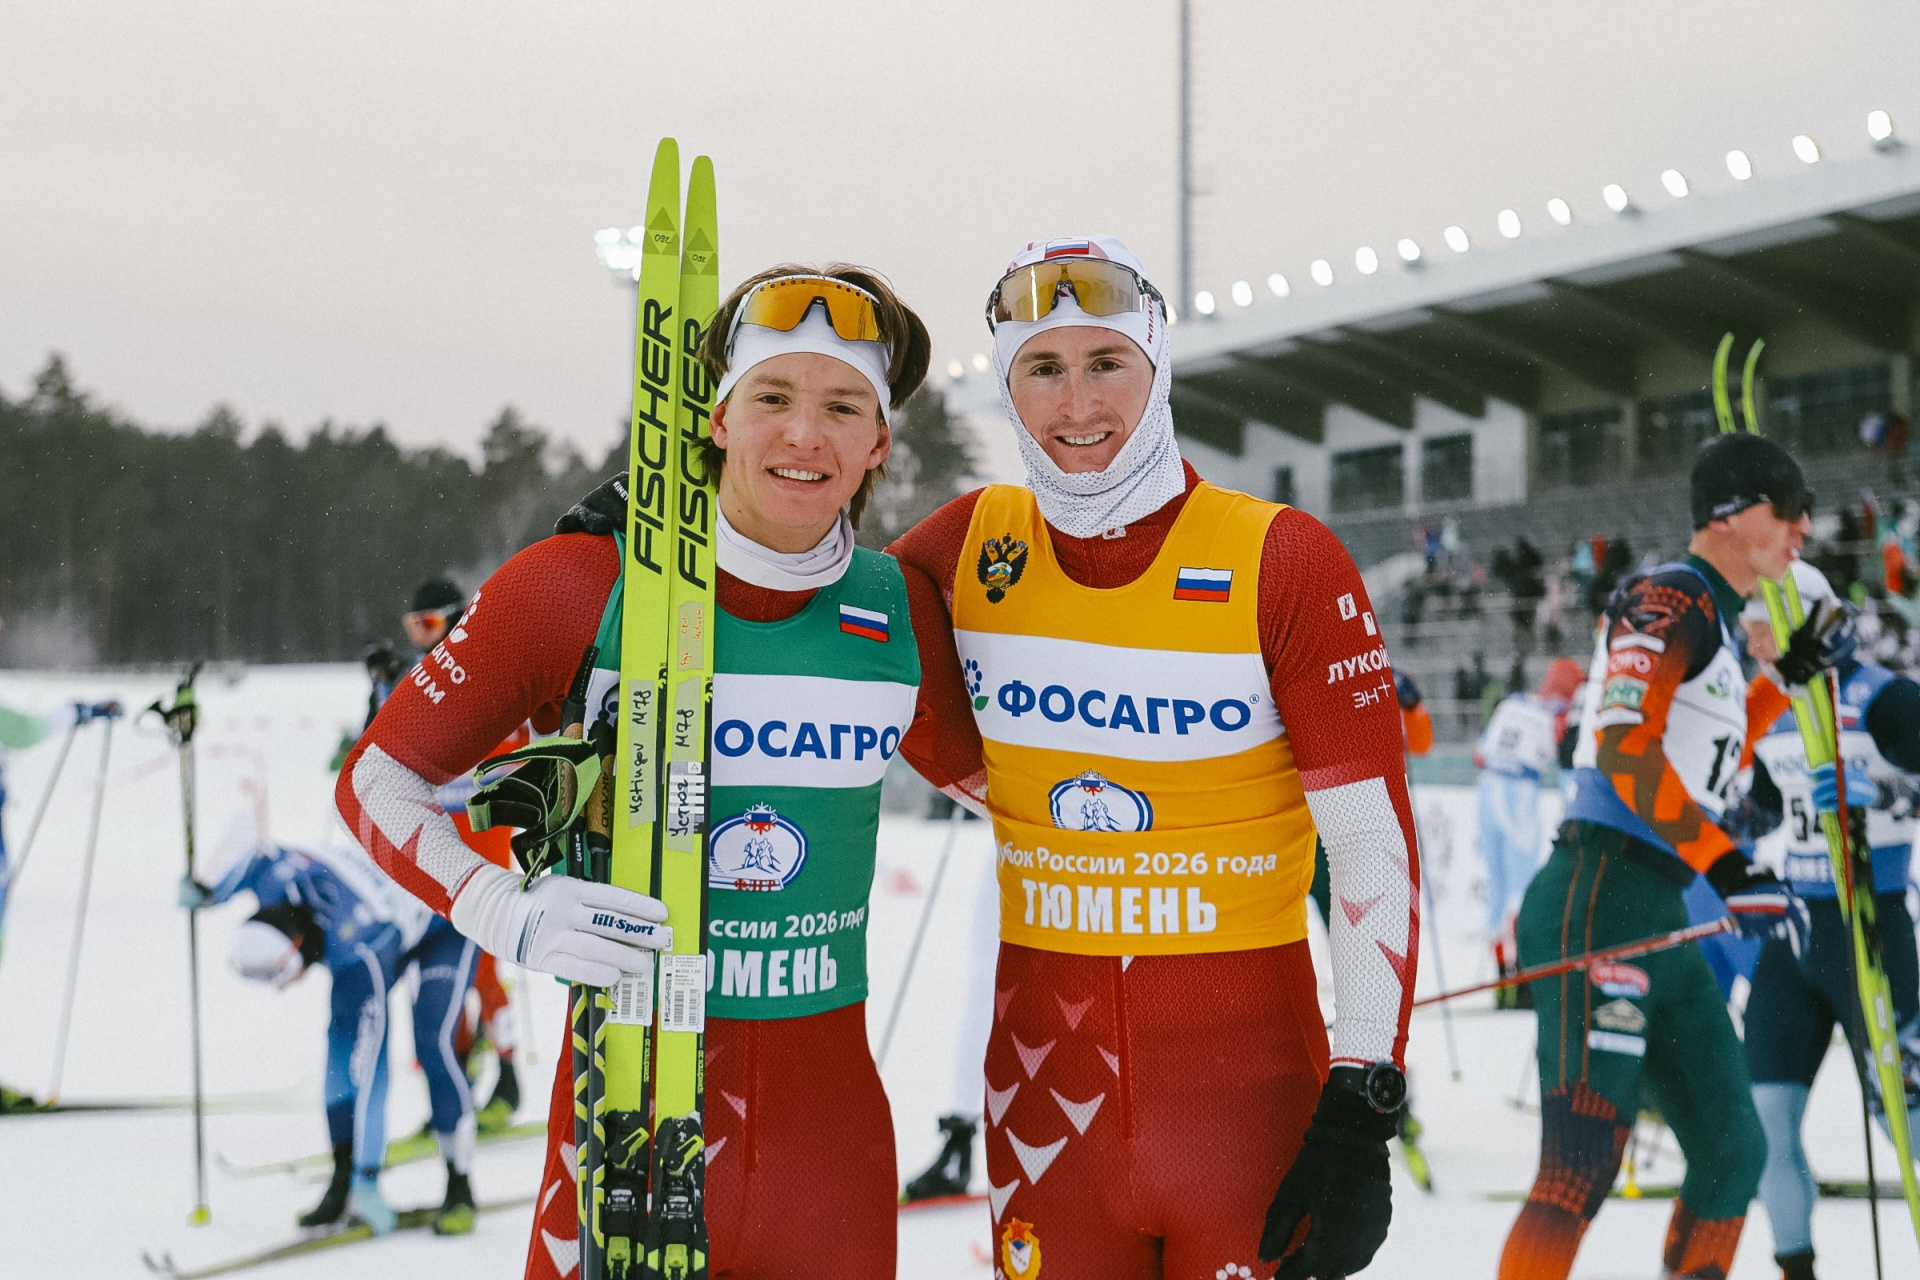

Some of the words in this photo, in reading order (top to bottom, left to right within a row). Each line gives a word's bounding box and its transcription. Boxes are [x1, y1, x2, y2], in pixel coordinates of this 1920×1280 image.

[633, 298, 673, 576] FISCHER
[1327, 643, 1391, 685] ЛУКОЙ
[998, 679, 1251, 735] ФОСАГРО
[713, 718, 900, 762] ОСАГРО
[997, 839, 1034, 868] убок
[1036, 846, 1125, 875] России
[1134, 852, 1209, 875] 2026
[1216, 853, 1277, 877] года
[708, 919, 777, 939] ссии
[783, 910, 837, 938] 2026
[1022, 878, 1217, 934] ТЮМЕНЬ
[707, 944, 837, 998] МЕНЬ
